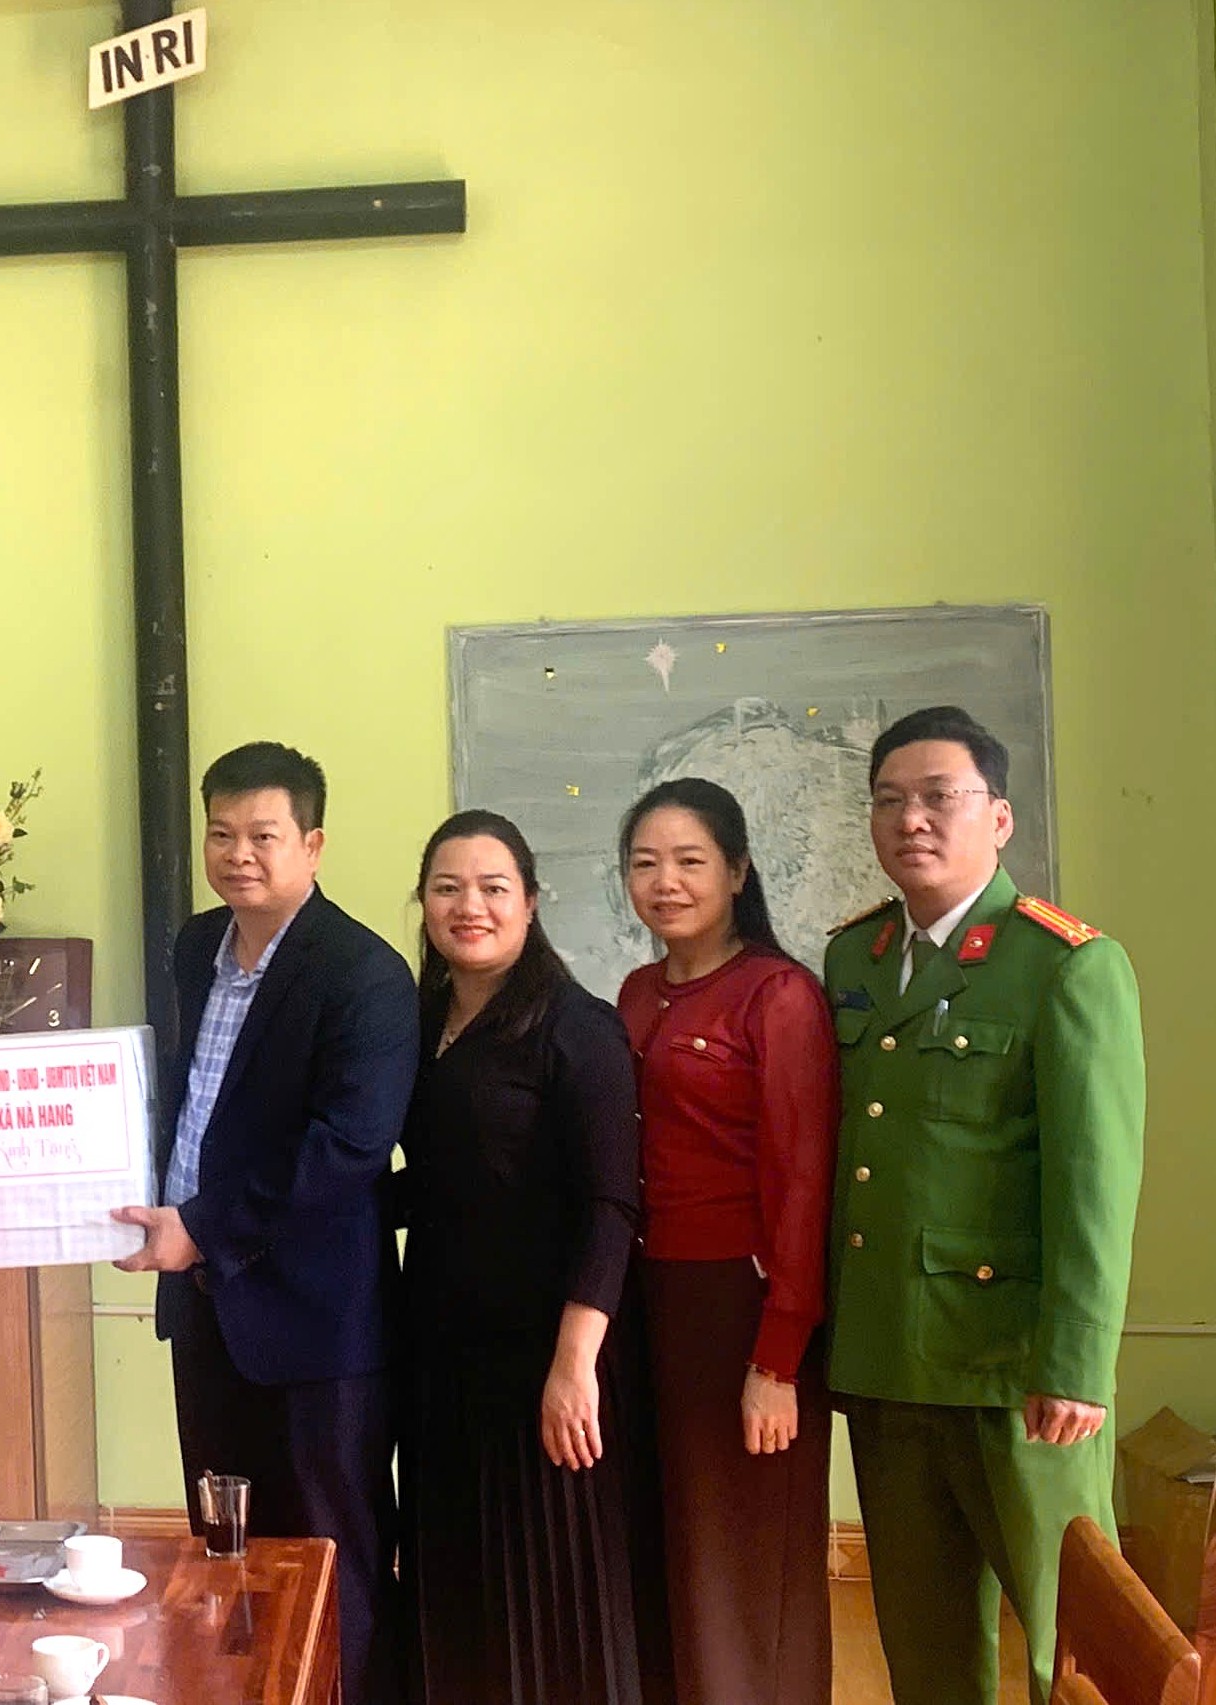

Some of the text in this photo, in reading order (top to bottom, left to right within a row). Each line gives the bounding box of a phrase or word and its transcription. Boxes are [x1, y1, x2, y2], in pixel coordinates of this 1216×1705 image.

[48, 1009, 61, 1027] 3
[97, 1063, 117, 1086] NAM
[16, 1100, 35, 1129] NÀ
[38, 1103, 74, 1128] HANG
